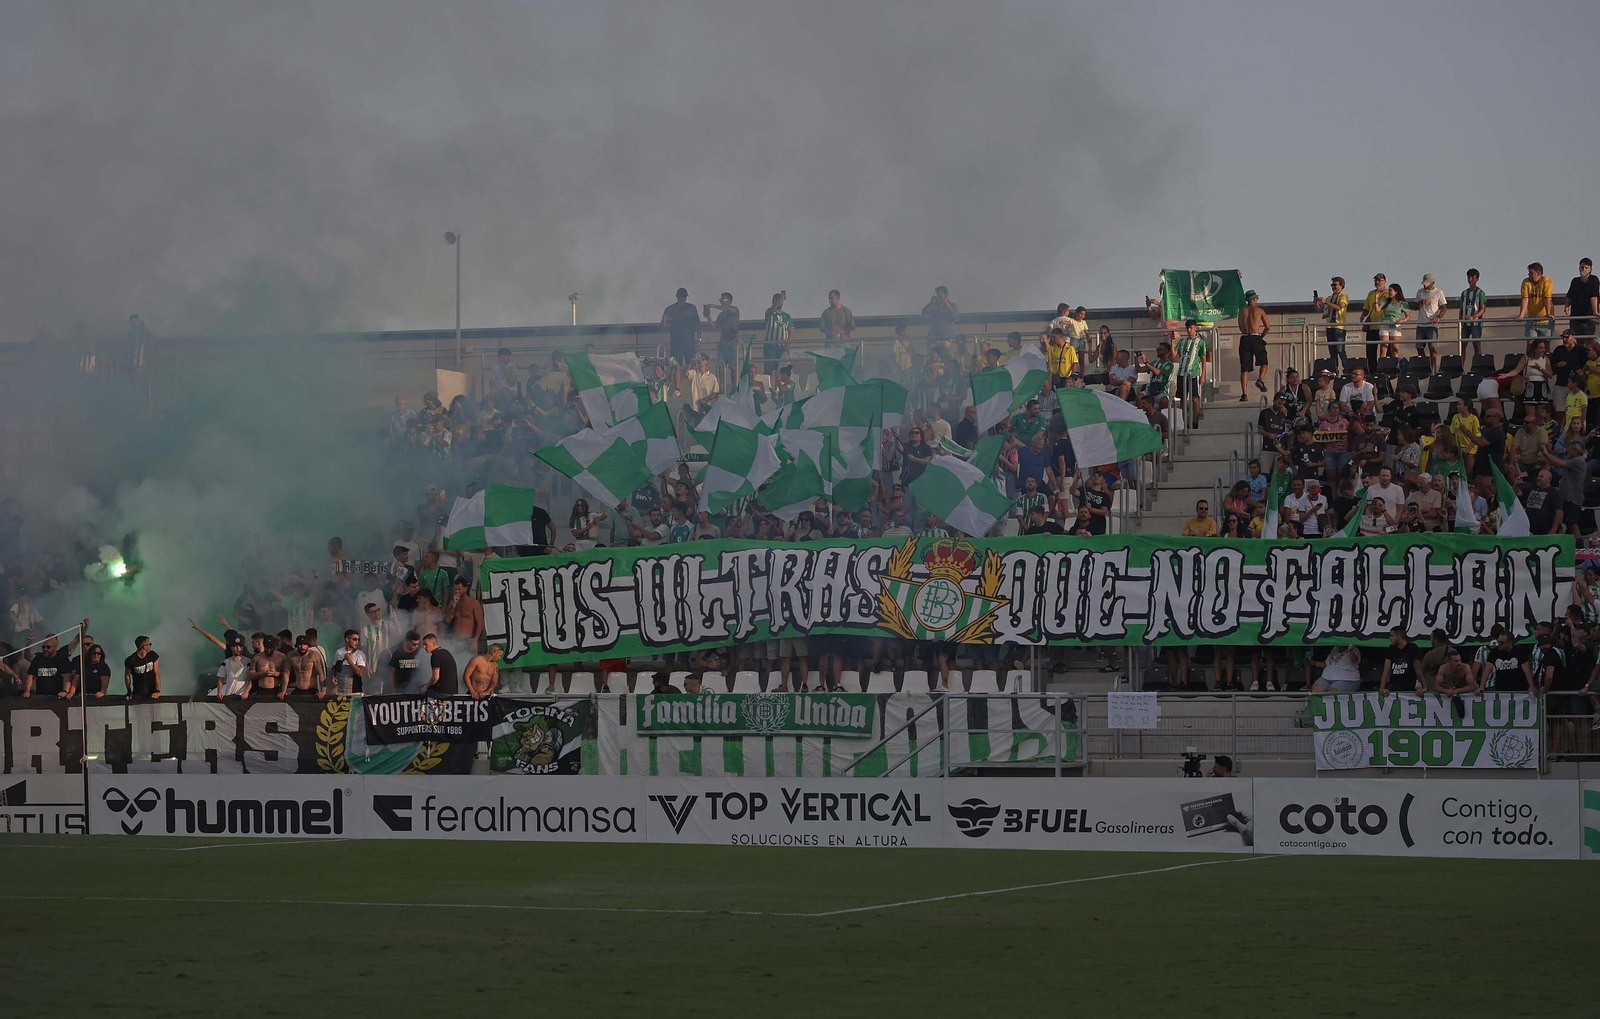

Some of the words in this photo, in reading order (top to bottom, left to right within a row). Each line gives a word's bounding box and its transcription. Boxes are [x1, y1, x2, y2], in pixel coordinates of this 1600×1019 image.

[488, 558, 620, 664] TUS
[634, 545, 896, 646] ULTRAS
[994, 546, 1130, 645] QUE
[1142, 546, 1244, 645] NO
[1257, 544, 1560, 645] FALLAN
[368, 700, 421, 726] YOUTH
[443, 700, 490, 723] BETIS
[1313, 692, 1539, 729] JUVENTUD
[0, 702, 300, 774] RTERS
[396, 724, 433, 736] SUPPORTERS
[447, 725, 463, 735] 1986
[1368, 730, 1487, 767] 1907
[515, 759, 559, 774] FANS
[165, 787, 344, 835] hummel
[421, 795, 637, 833] feralmansa
[705, 791, 768, 821] TOP
[780, 787, 931, 827] VERTICAL
[1278, 797, 1388, 836] coto
[1441, 797, 1539, 824] Contigo,
[0, 813, 85, 833] TUS
[1003, 808, 1093, 833] BFUEL
[1095, 821, 1175, 834] Gasolineras
[731, 833, 819, 846] SOLUCIONES
[829, 834, 845, 846] EN
[855, 835, 908, 847] ALTURA
[1279, 840, 1347, 850] cotocontigo.pro
[1443, 829, 1483, 845] con
[1492, 824, 1553, 846] todo.
